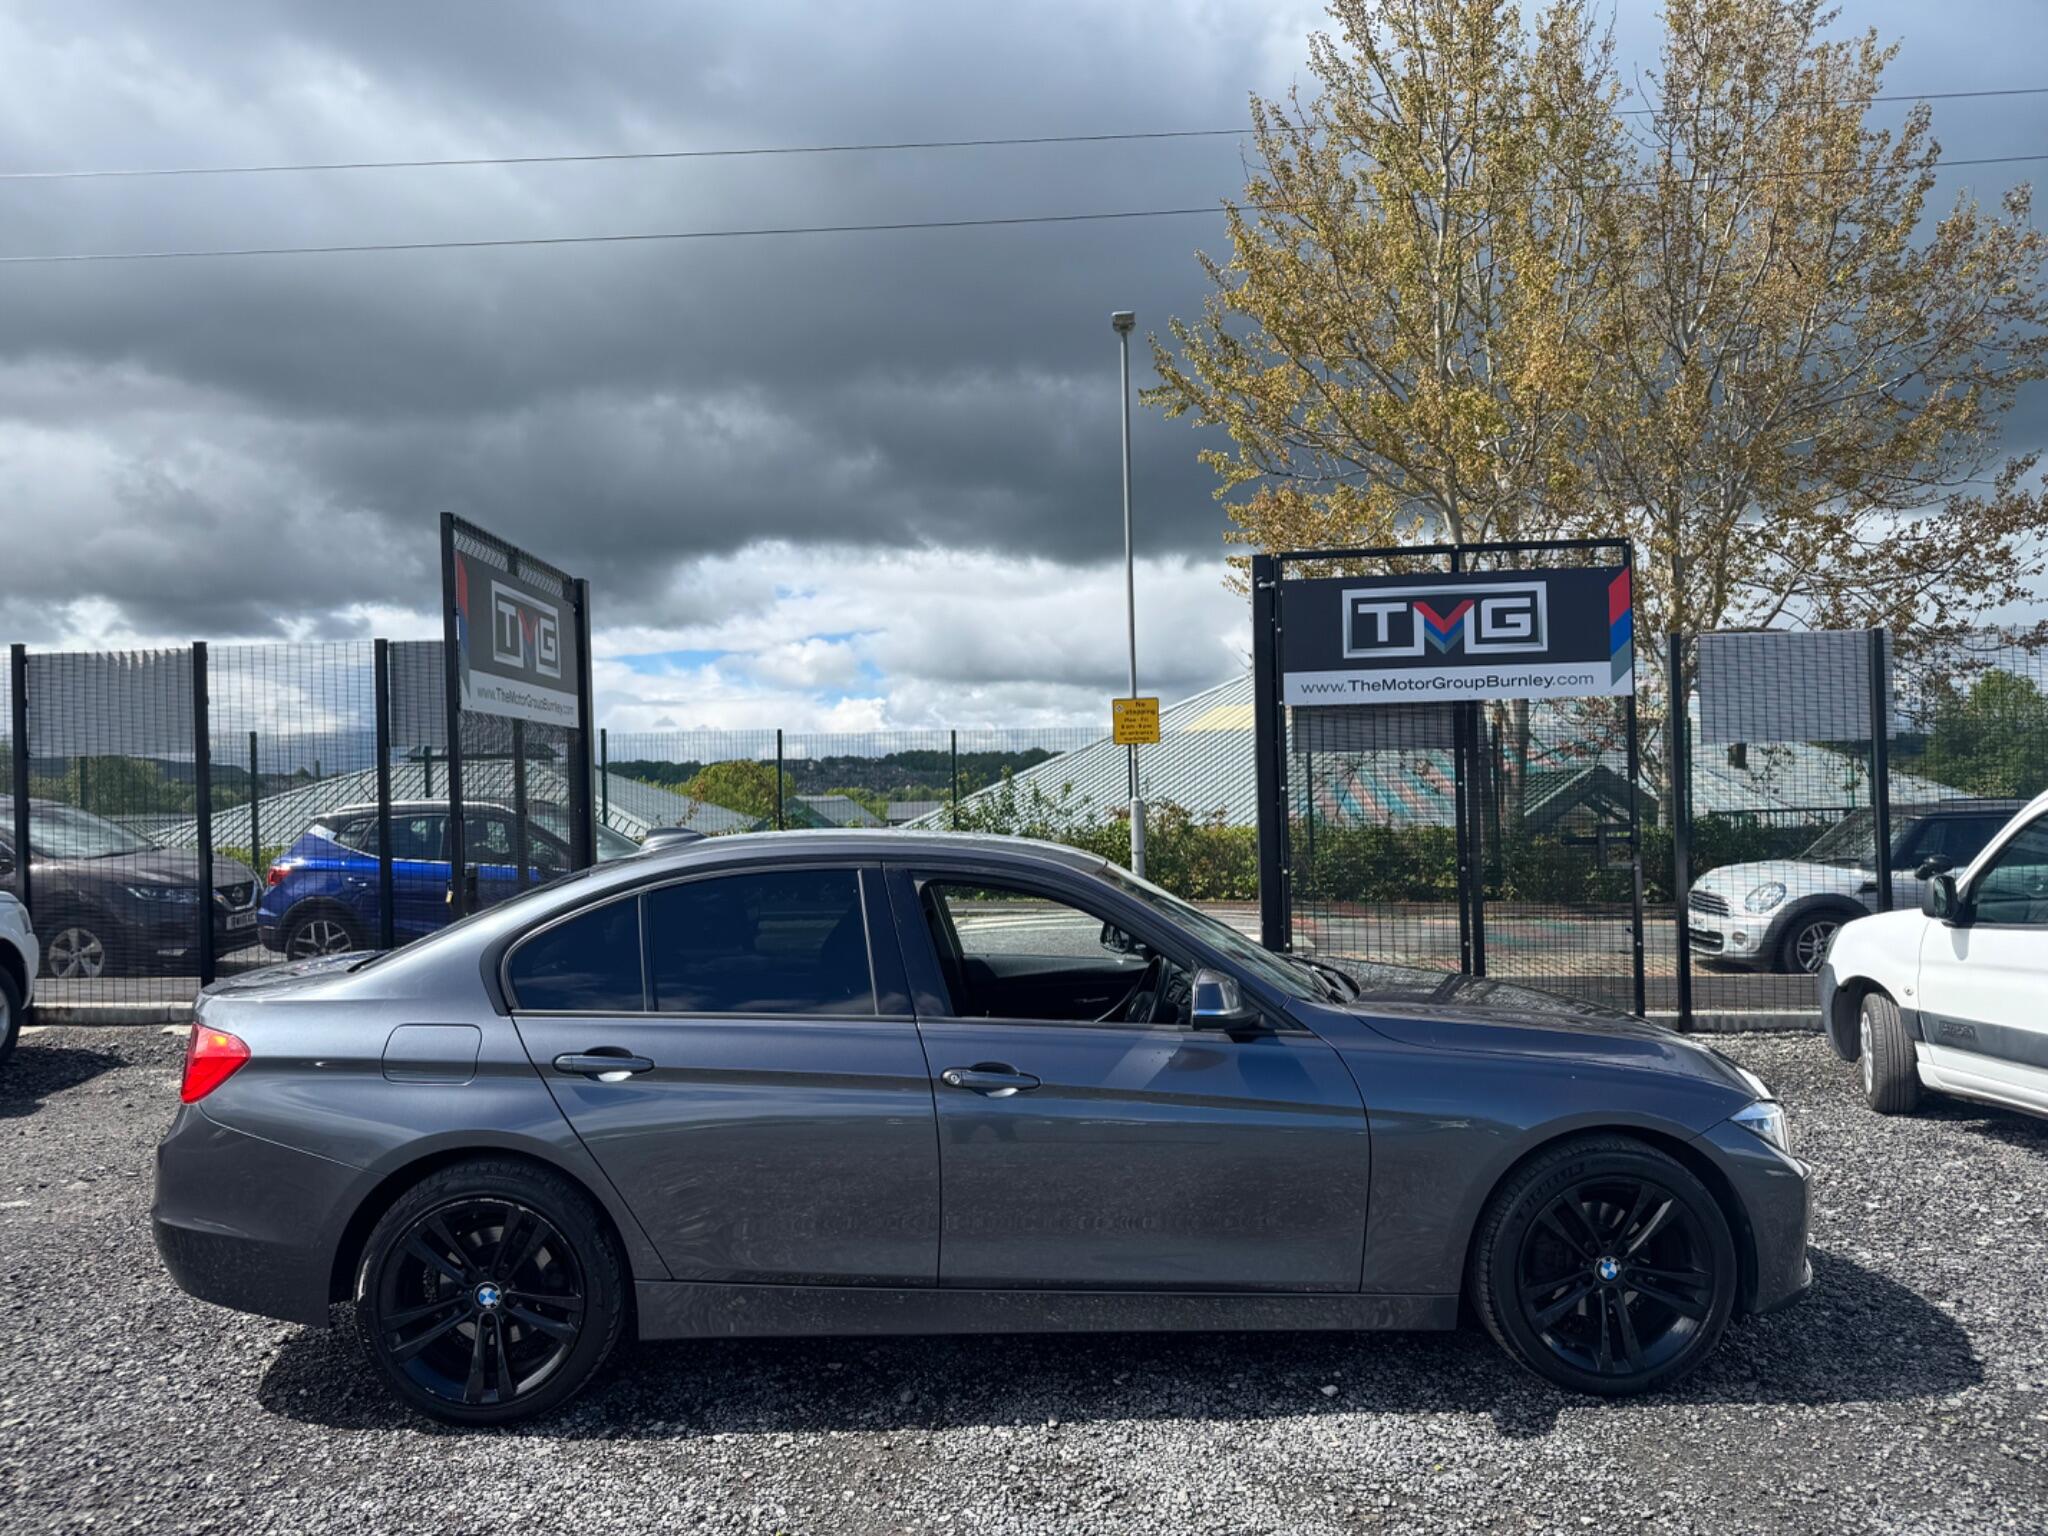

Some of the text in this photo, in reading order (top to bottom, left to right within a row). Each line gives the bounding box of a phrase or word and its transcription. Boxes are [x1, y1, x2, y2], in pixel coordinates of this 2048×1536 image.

[496, 599, 556, 669] TMG
[1357, 597, 1532, 655] TMG
[1300, 673, 1595, 695] www.TheMotorGroupBurnley.com
